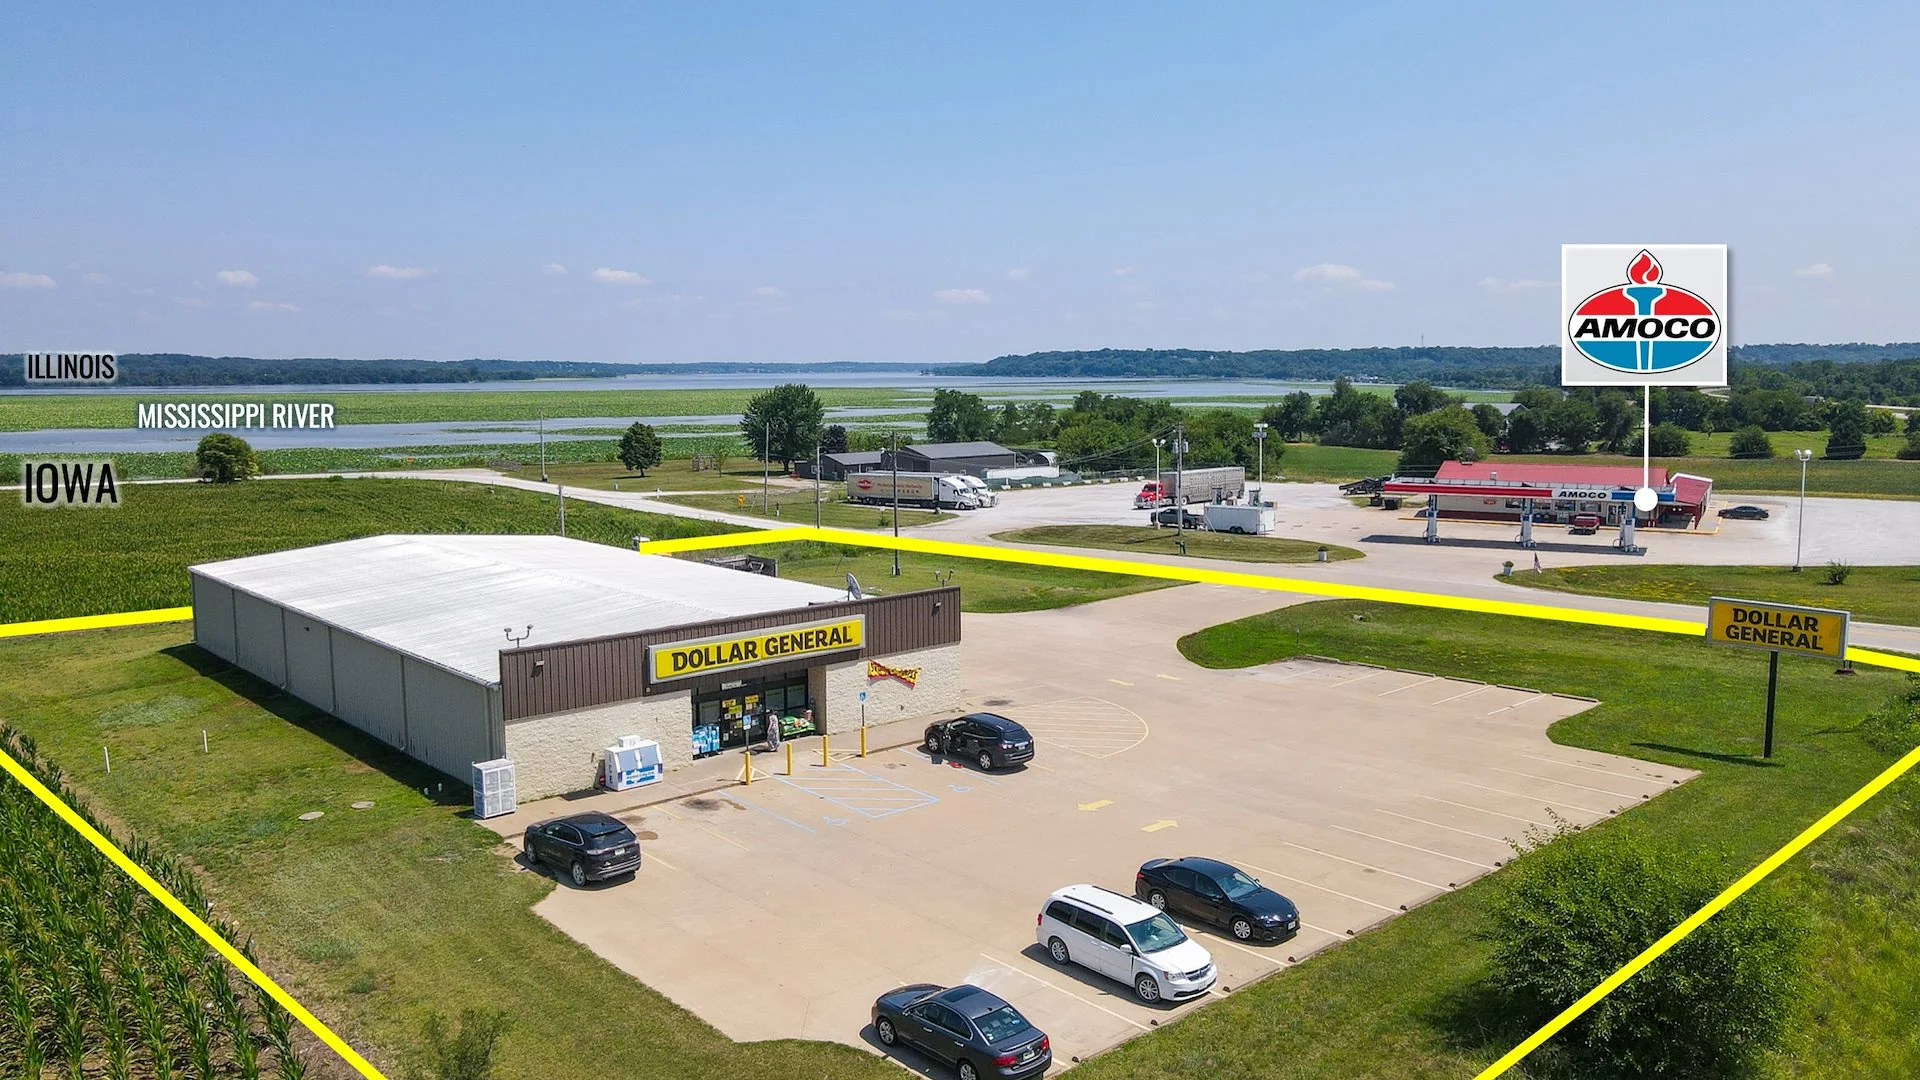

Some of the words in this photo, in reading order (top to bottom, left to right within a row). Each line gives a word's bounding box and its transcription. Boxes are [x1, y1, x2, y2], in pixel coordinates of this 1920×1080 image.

[1558, 490, 1607, 500] AMOCO
[1732, 607, 1819, 633] DOLLAR
[672, 640, 758, 672] DOLLAR
[764, 626, 853, 656] GENERAL
[1725, 624, 1824, 651] GENERAL
